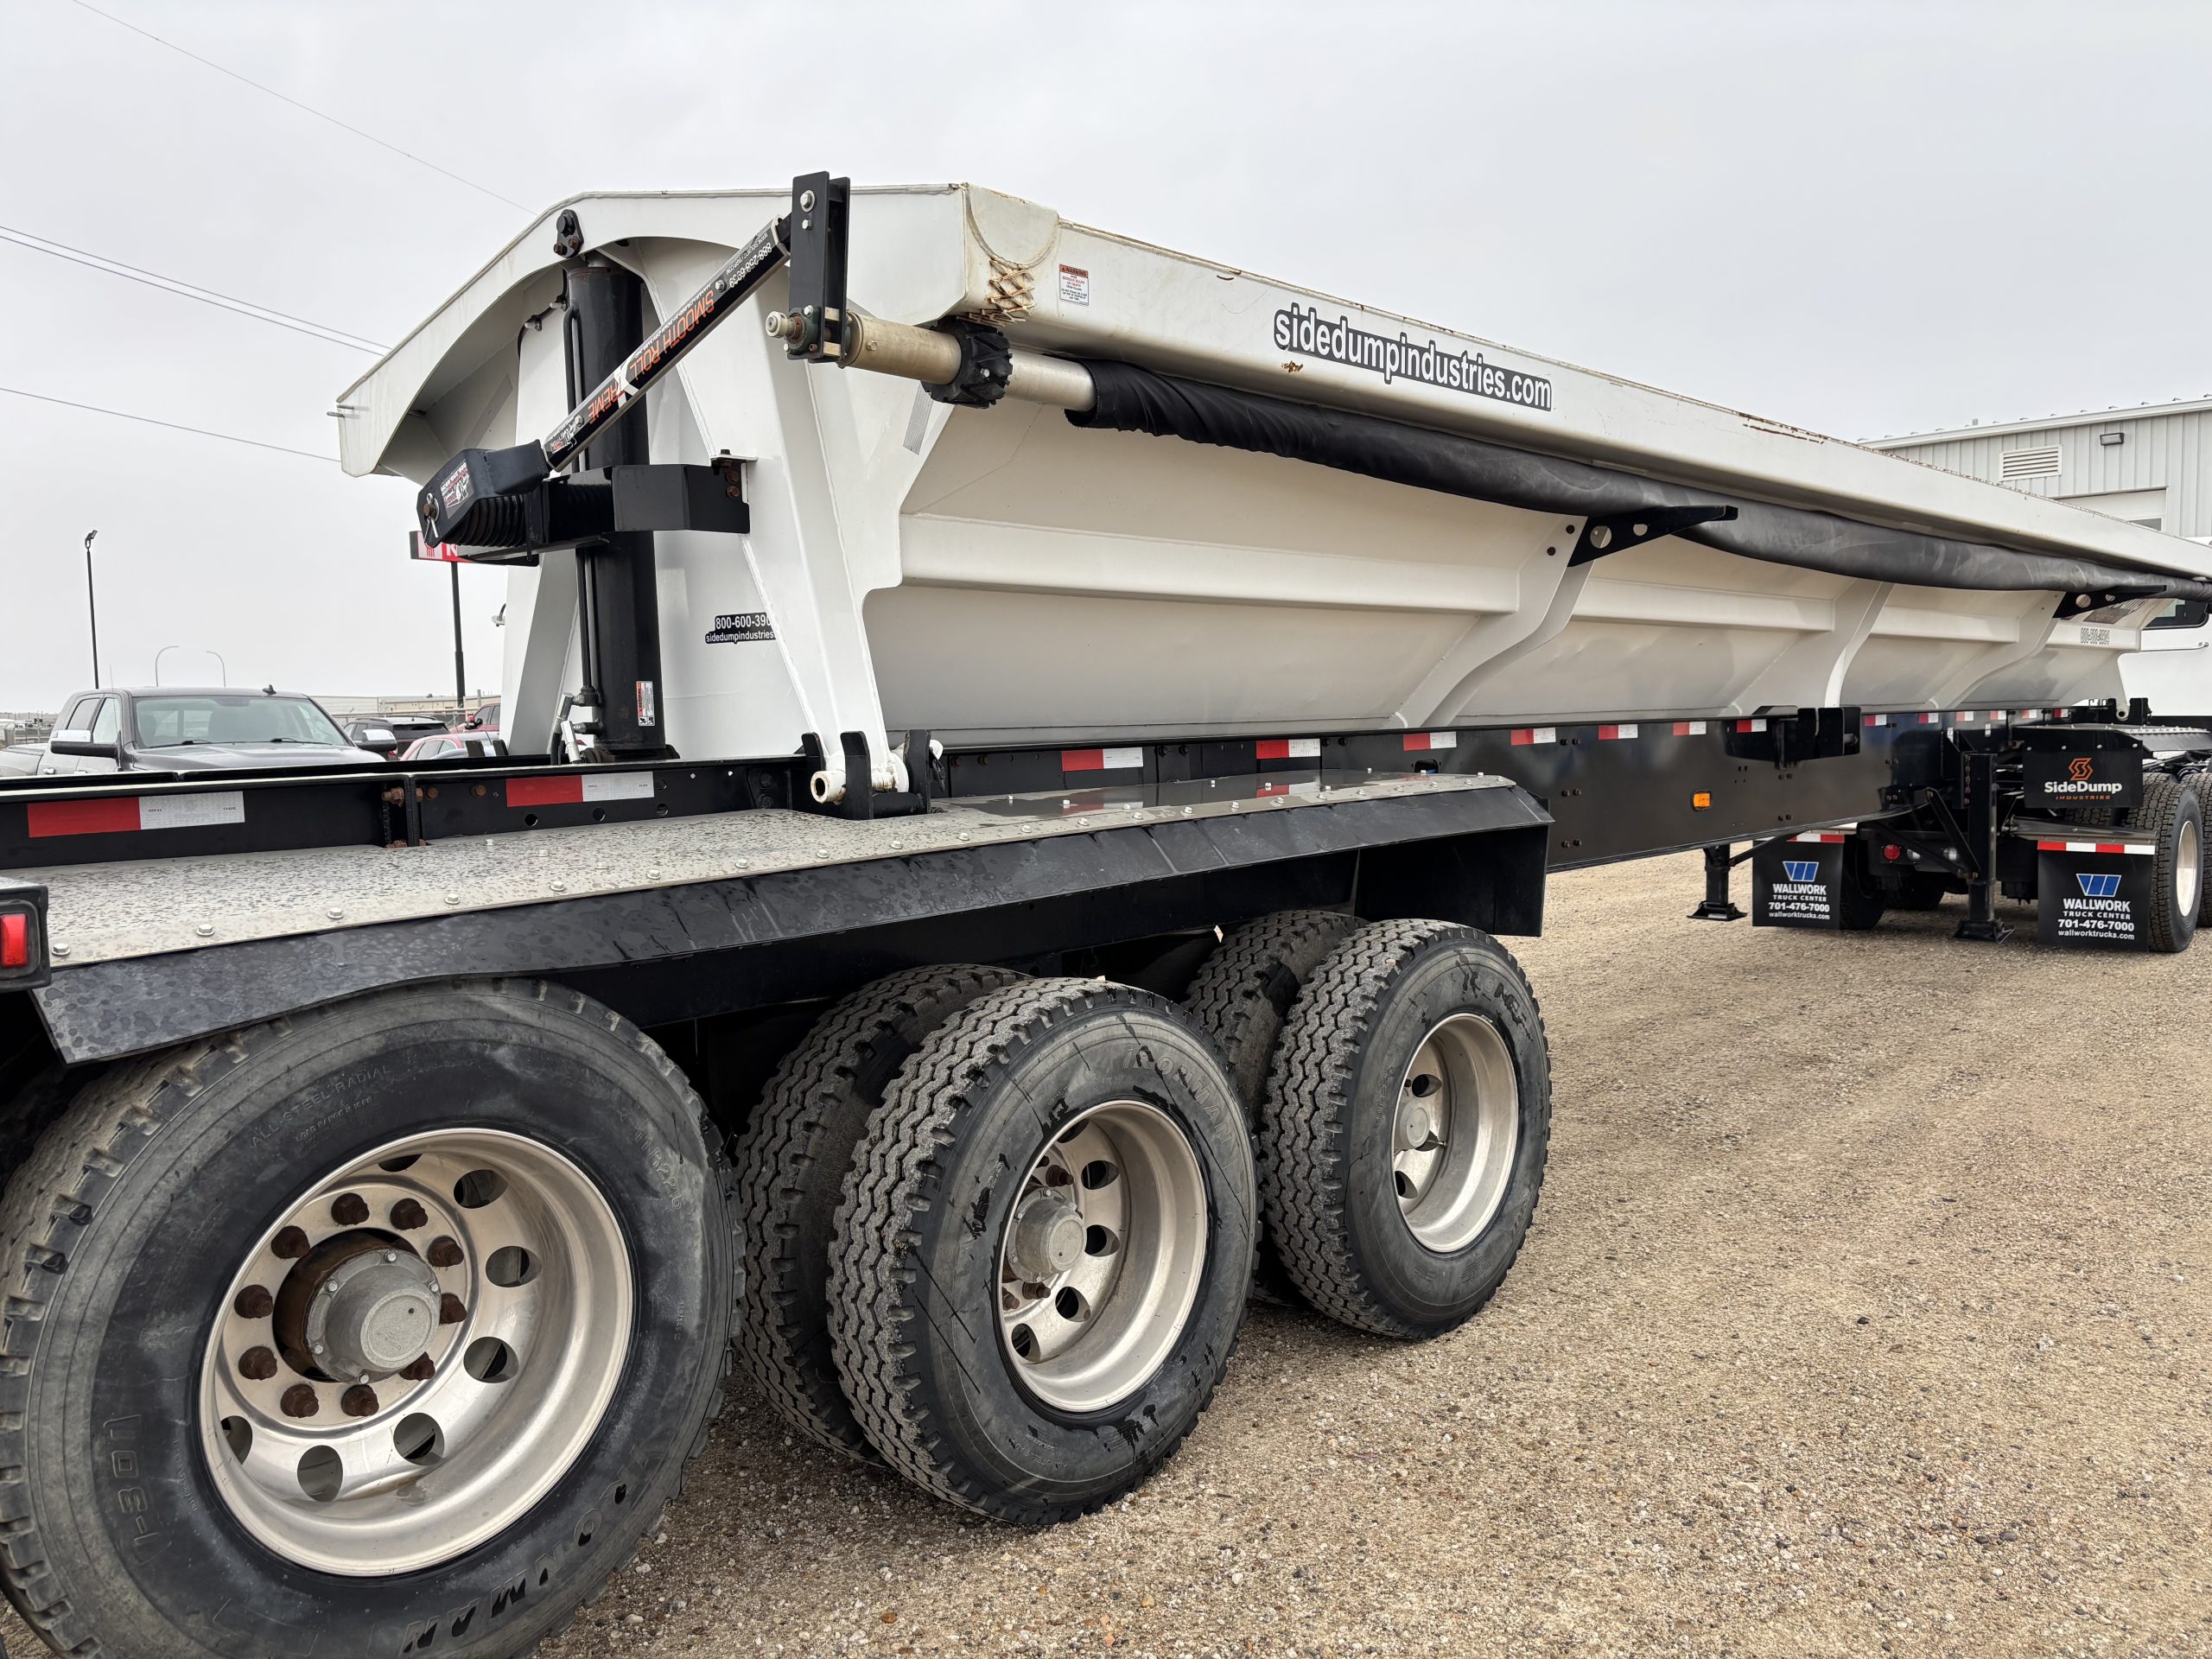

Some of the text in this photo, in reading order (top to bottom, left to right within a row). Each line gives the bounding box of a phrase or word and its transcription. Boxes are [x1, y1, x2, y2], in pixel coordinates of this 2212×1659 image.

[663, 289, 715, 354] SMOOTH
[630, 340, 661, 380] ROLL
[1274, 306, 1552, 410] sidedumpindustries.com
[715, 614, 771, 629] 800-600-390
[2044, 780, 2122, 794] SideDump
[1772, 883, 1827, 895] WALLWORK
[1768, 902, 1830, 912] 701-476-7000
[2063, 898, 2131, 912] WALLWORK
[2096, 912, 2131, 920] CENTER
[2057, 918, 2135, 931] 701-476-7000
[2057, 929, 2135, 940] wallworktrucks.com
[335, 1065, 391, 1093] RADIAL
